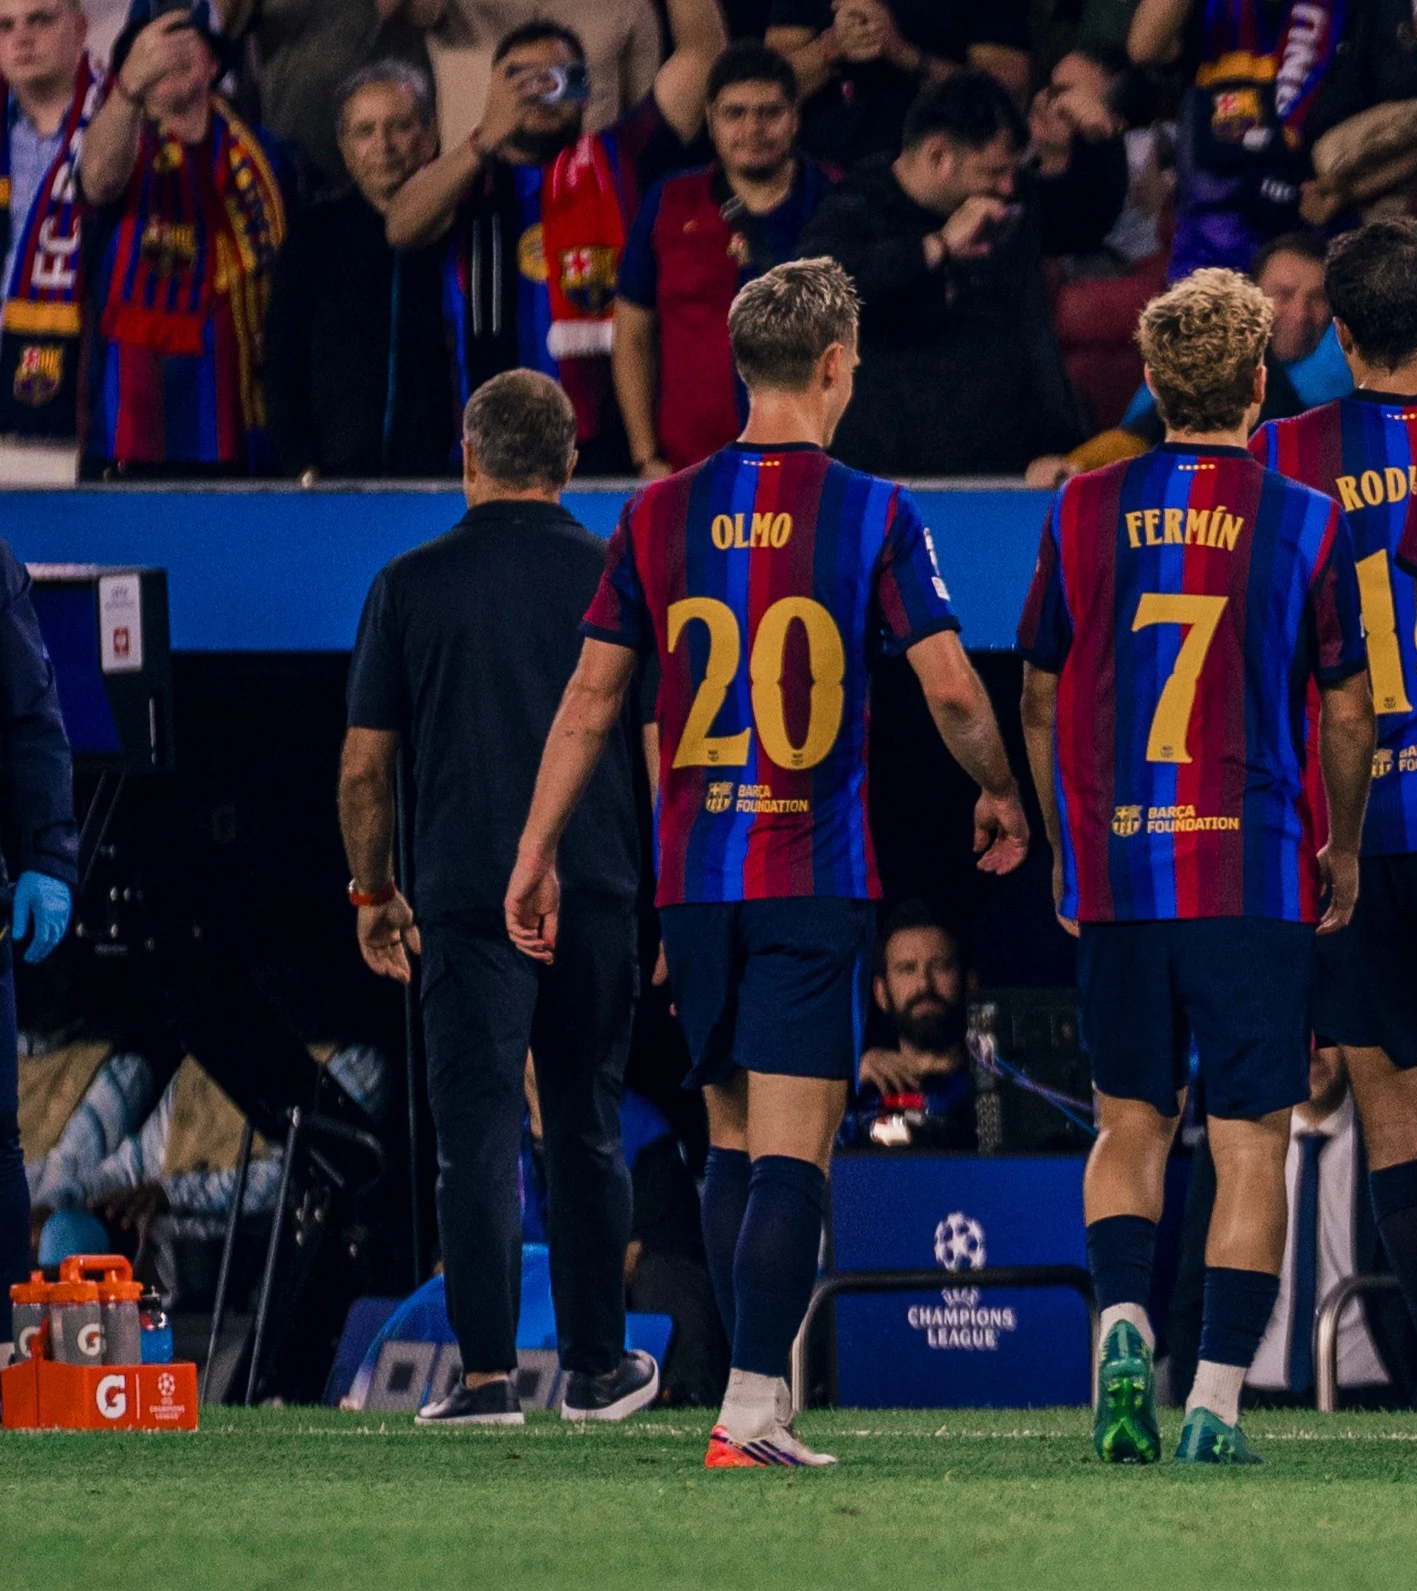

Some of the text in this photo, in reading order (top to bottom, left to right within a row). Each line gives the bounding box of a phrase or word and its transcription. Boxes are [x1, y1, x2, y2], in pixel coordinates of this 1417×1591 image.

[711, 512, 793, 550] OLMO
[1125, 505, 1244, 551] FERMÍN
[667, 596, 846, 771] 20
[1131, 593, 1229, 764] 7
[738, 784, 772, 799] BARÇA
[736, 799, 810, 813] FOUNDATION
[1148, 804, 1197, 819] BARÇA
[1146, 816, 1240, 834] FOUNDATION
[907, 1305, 1016, 1330] CHAMPIONS
[927, 1328, 998, 1350] LEAGUE
[96, 1374, 128, 1420] G
